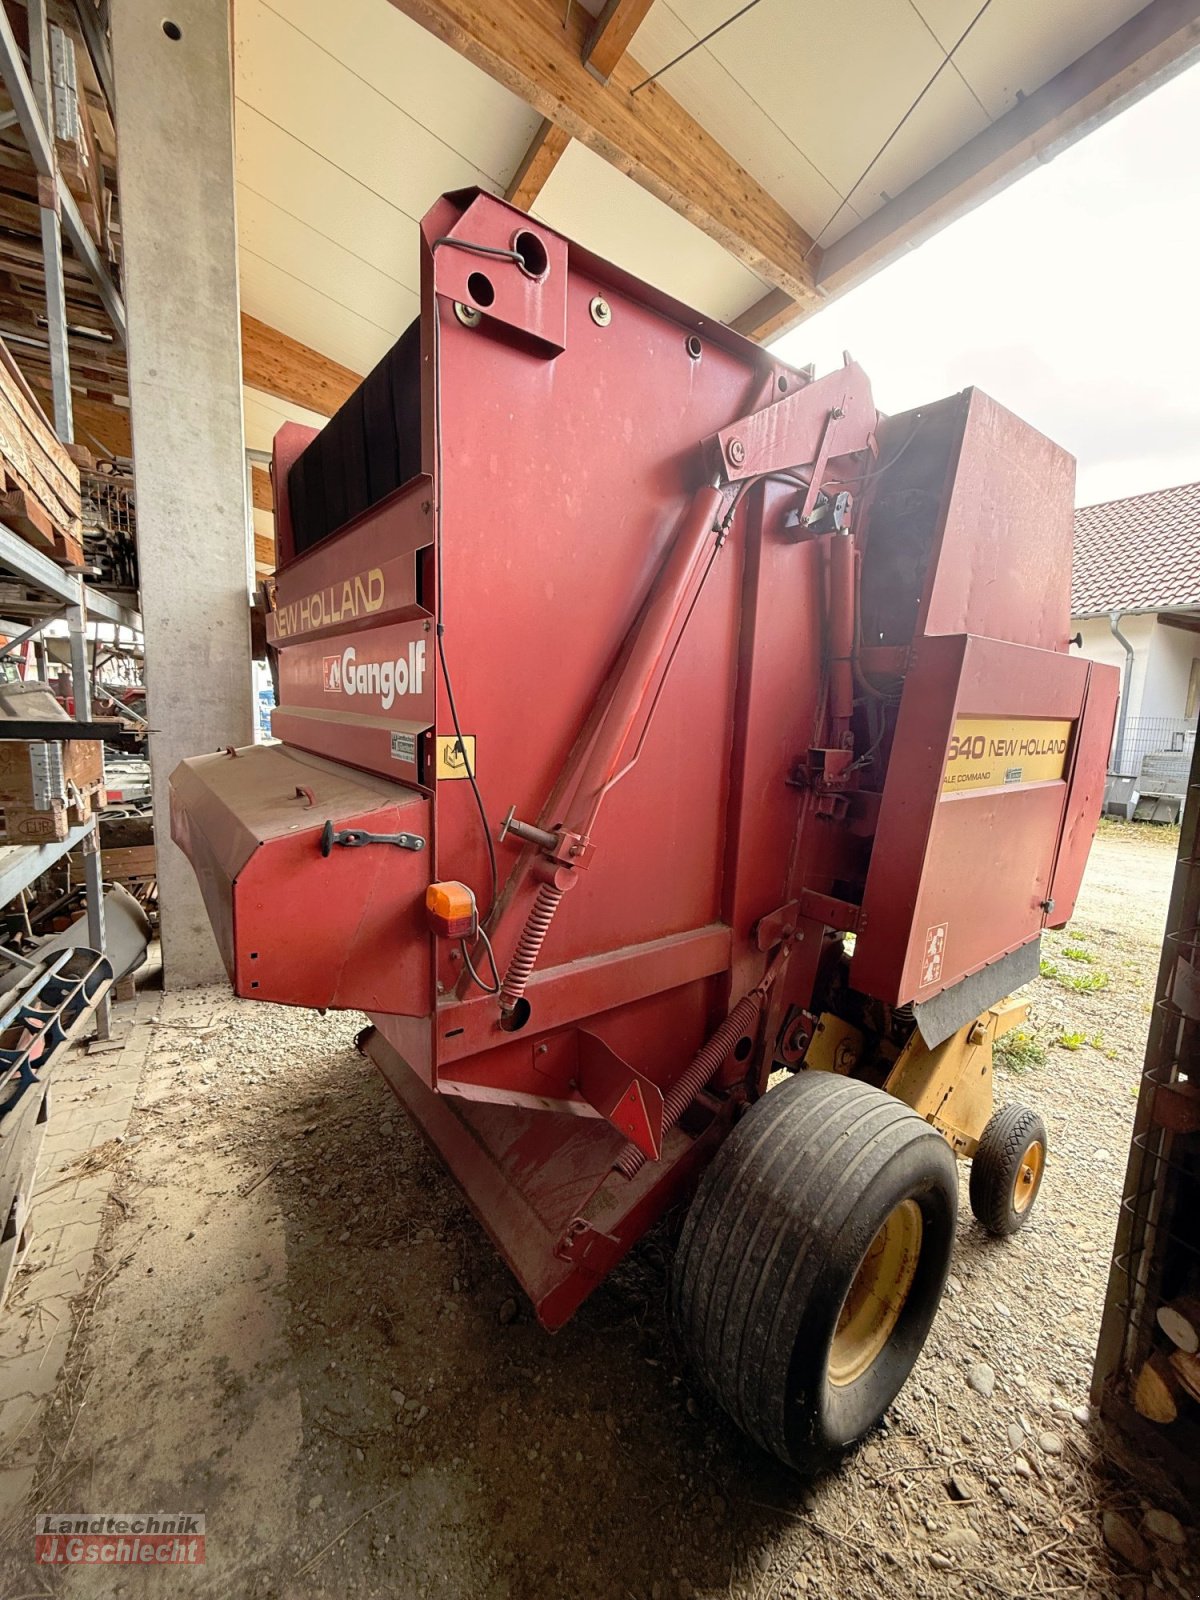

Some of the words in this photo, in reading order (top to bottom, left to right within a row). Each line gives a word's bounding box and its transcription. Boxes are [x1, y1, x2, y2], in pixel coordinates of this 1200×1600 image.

[273, 603, 298, 639] NEW
[300, 567, 385, 631] HOLLAND
[342, 640, 426, 710] Gangolf
[948, 735, 986, 760] 640
[989, 739, 1019, 757] NEW
[1019, 738, 1067, 756] HOLLAND
[957, 771, 991, 783] COMMAND
